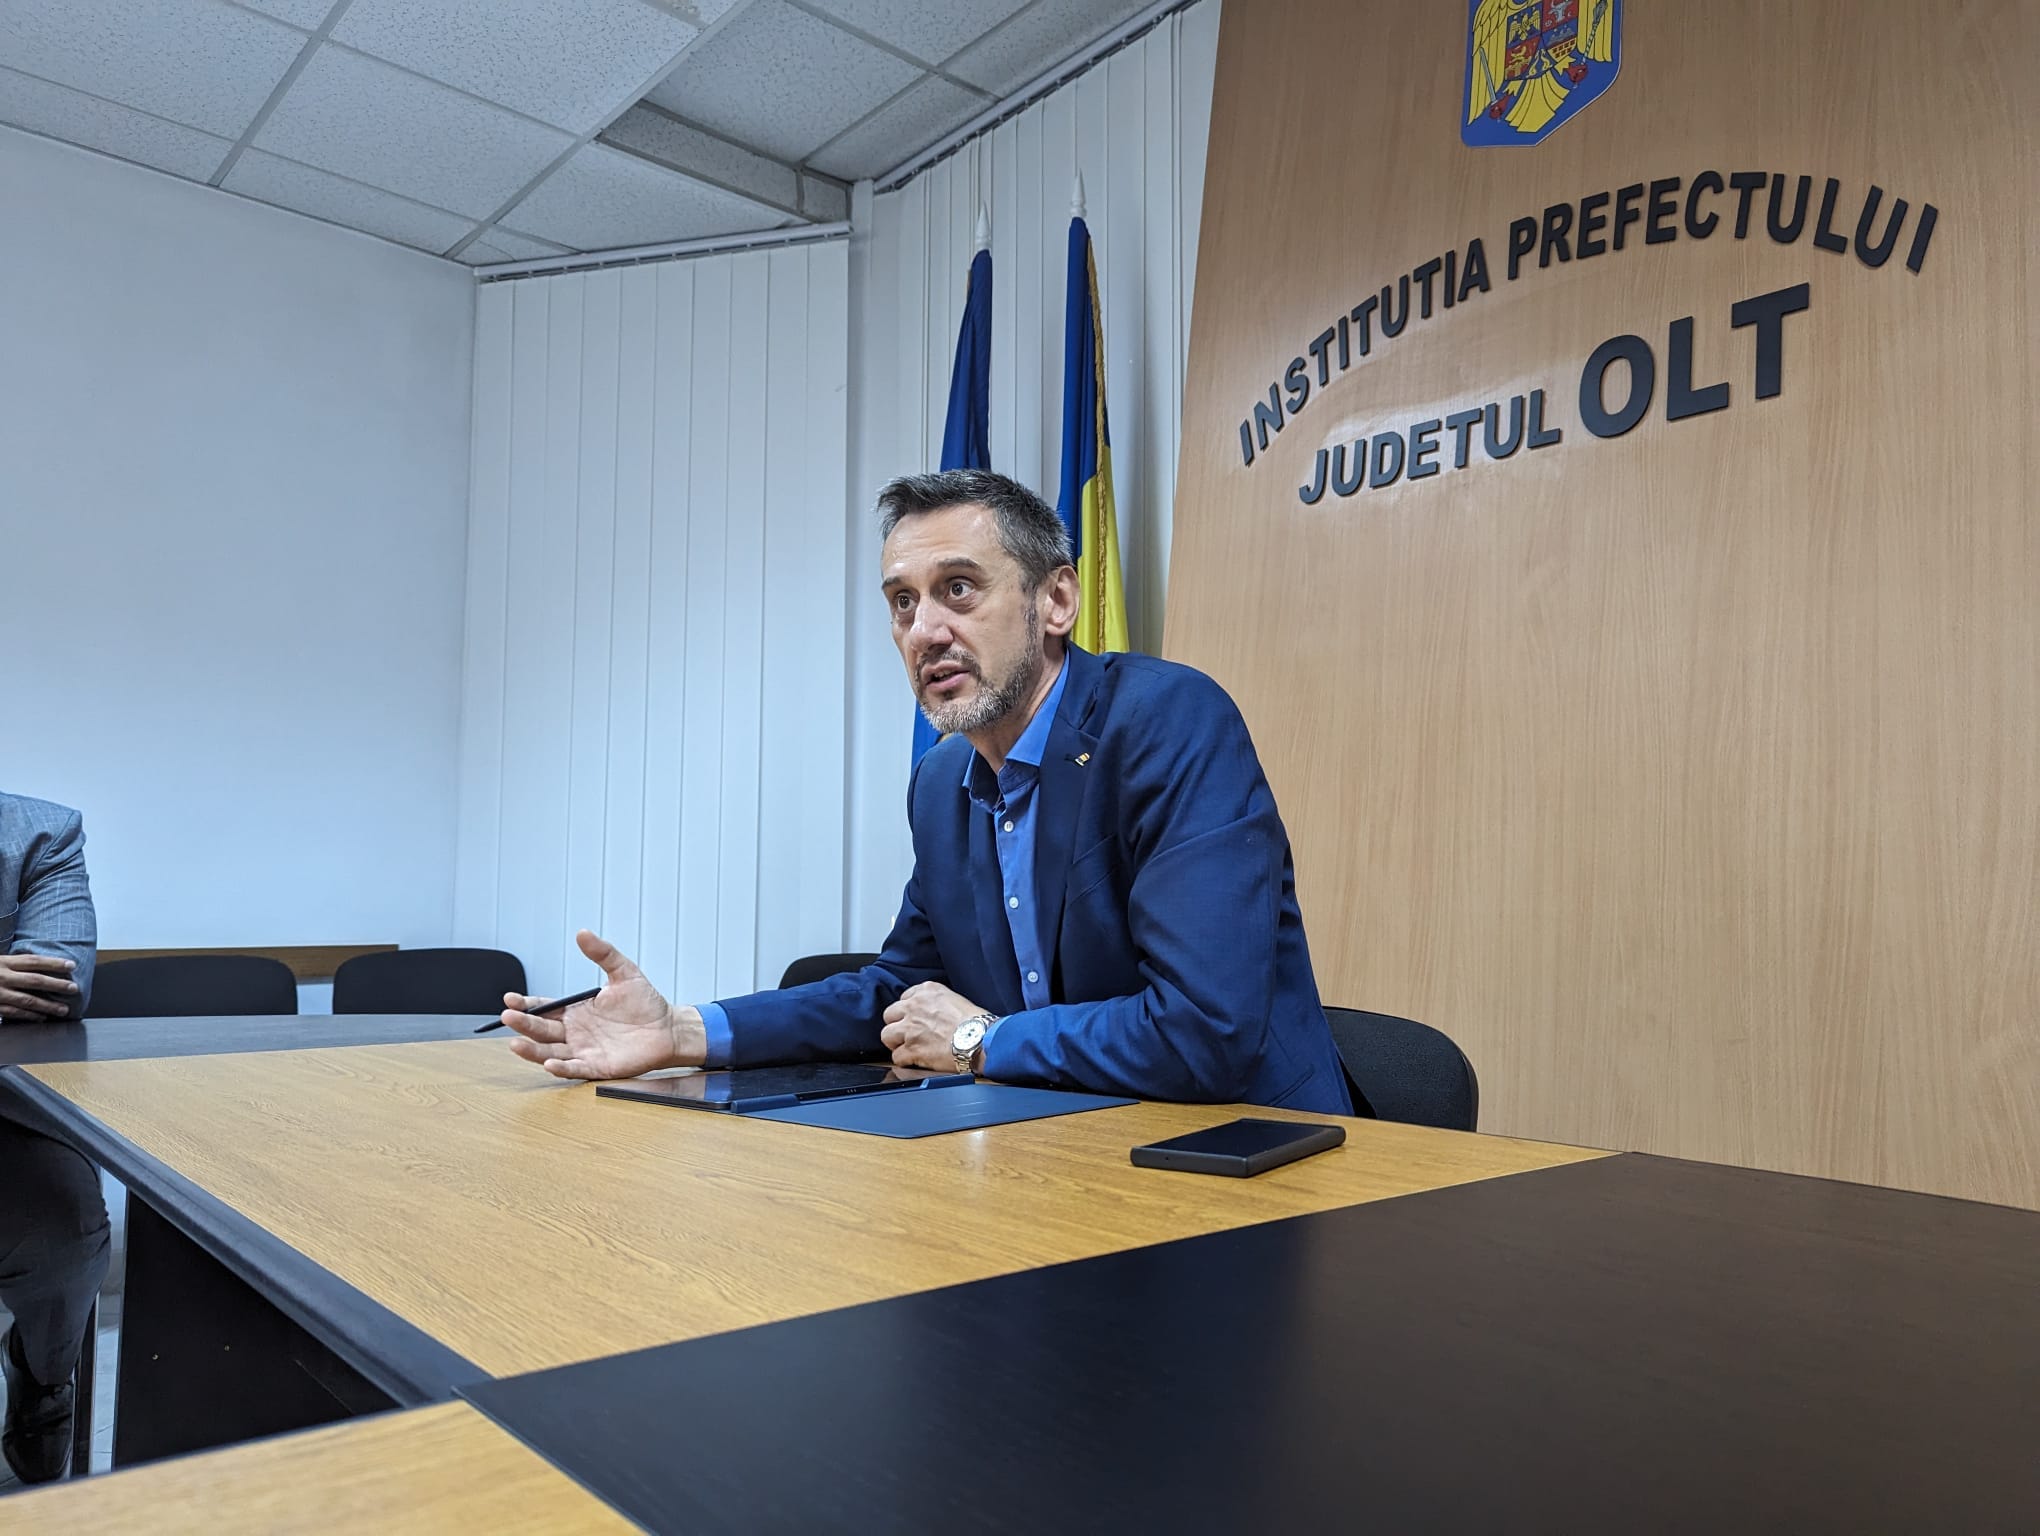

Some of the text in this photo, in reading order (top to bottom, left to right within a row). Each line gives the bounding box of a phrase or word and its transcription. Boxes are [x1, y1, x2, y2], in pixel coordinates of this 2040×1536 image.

[1239, 170, 1939, 466] INSTITUTIA PREFECTULUI
[1299, 283, 1810, 505] JUDETUL OLT
